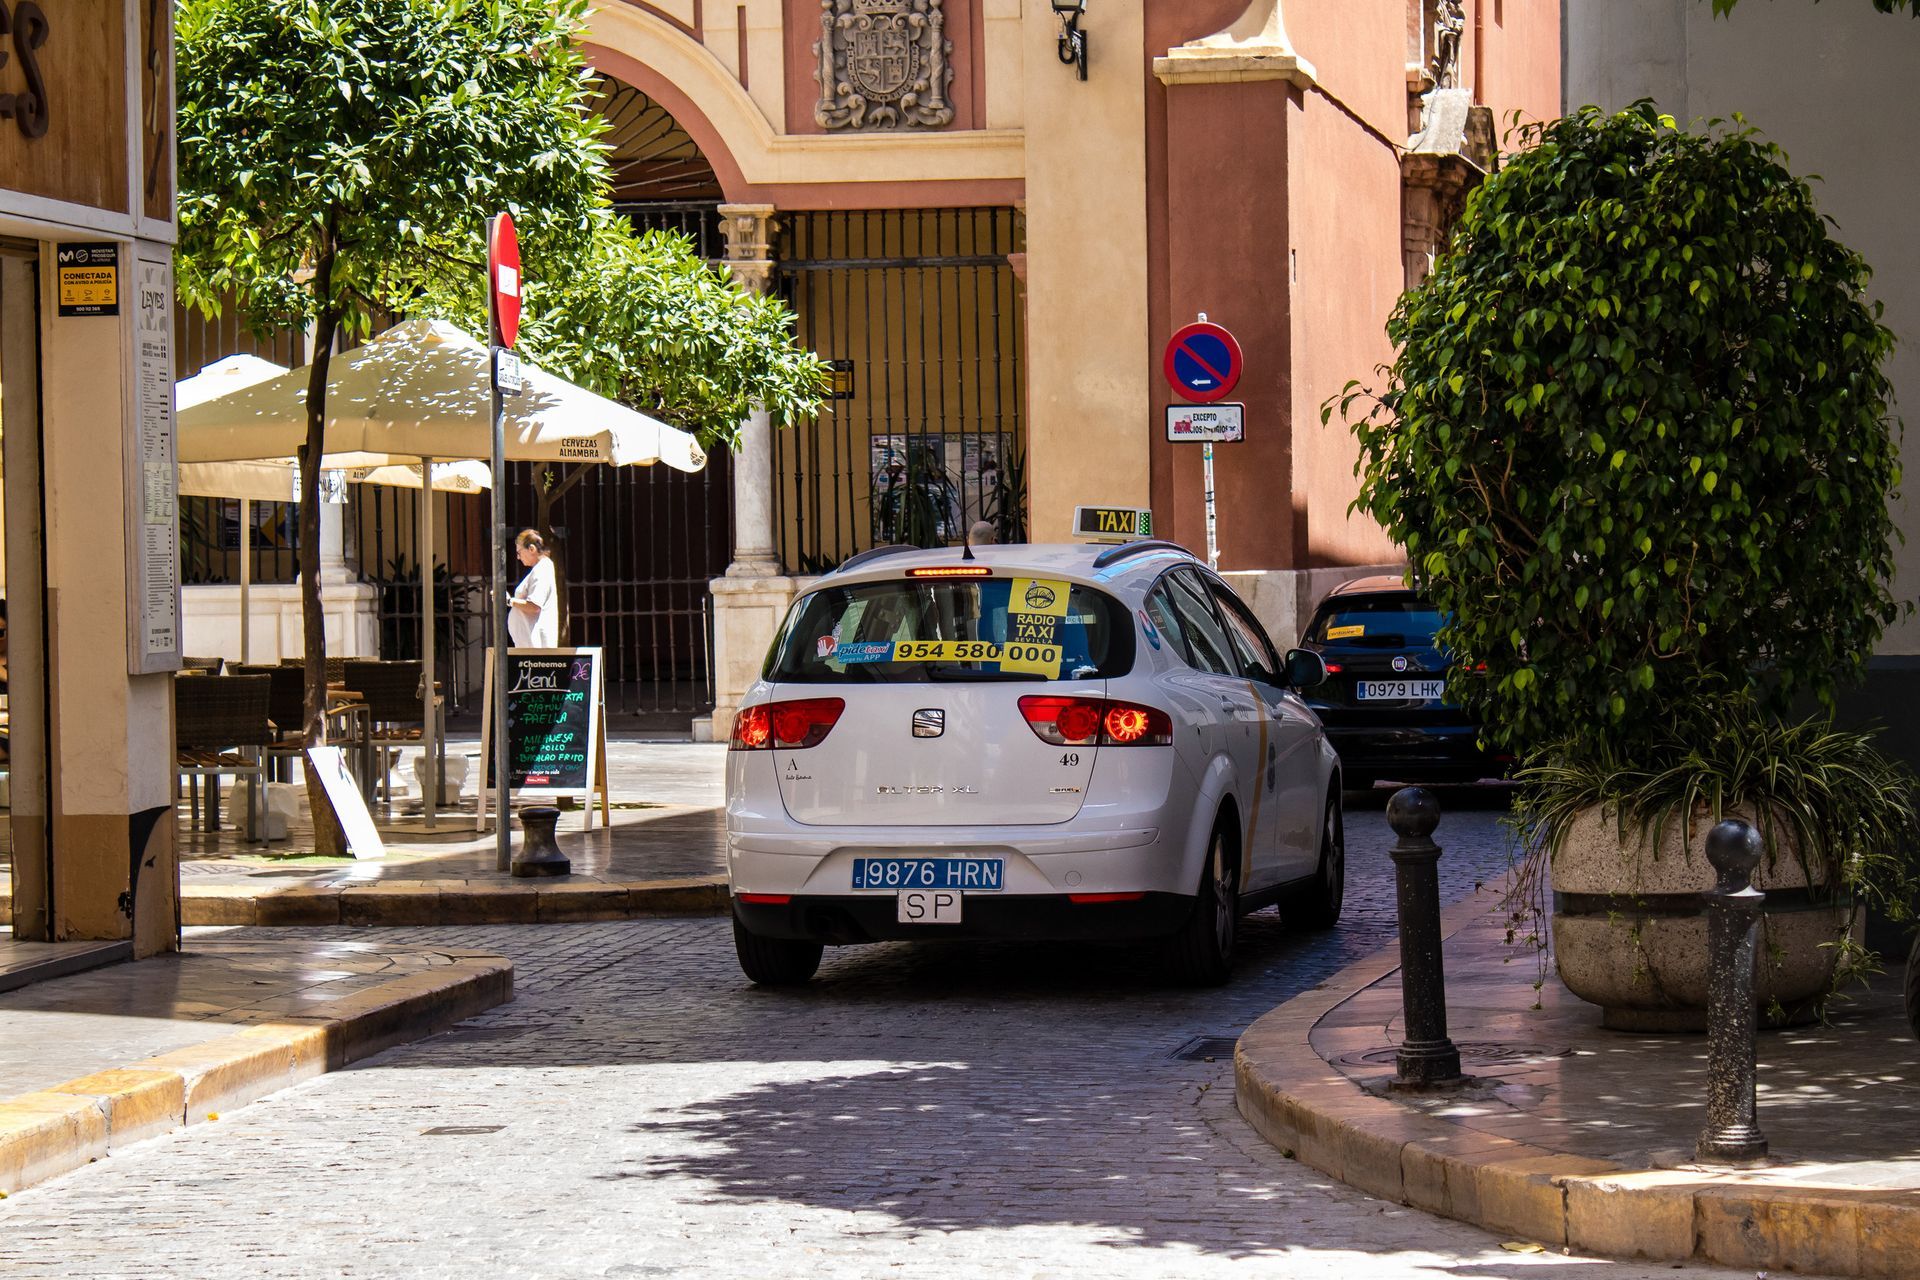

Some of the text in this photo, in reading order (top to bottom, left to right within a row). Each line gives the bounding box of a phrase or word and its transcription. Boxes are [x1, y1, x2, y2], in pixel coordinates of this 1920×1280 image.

[64, 272, 112, 280] CONECTADA
[1192, 412, 1218, 422] EXCEPTO
[561, 438, 598, 448] CERVEZAS
[559, 448, 599, 458] ALHAMBRA
[1096, 510, 1135, 532] TAXI
[1017, 614, 1056, 626] RADIO
[1016, 624, 1055, 639] TAXI
[863, 653, 881, 661] APP
[898, 643, 1056, 663] 954 580 000
[518, 660, 567, 668] #Chateemos
[512, 668, 557, 691] Menú
[1368, 682, 1440, 697] 0979 LHK
[540, 744, 566, 752] POLLO
[558, 753, 585, 763] FRITO
[1059, 752, 1080, 767] 49
[952, 785, 979, 795] XL
[855, 861, 999, 886] E 9876 HRN
